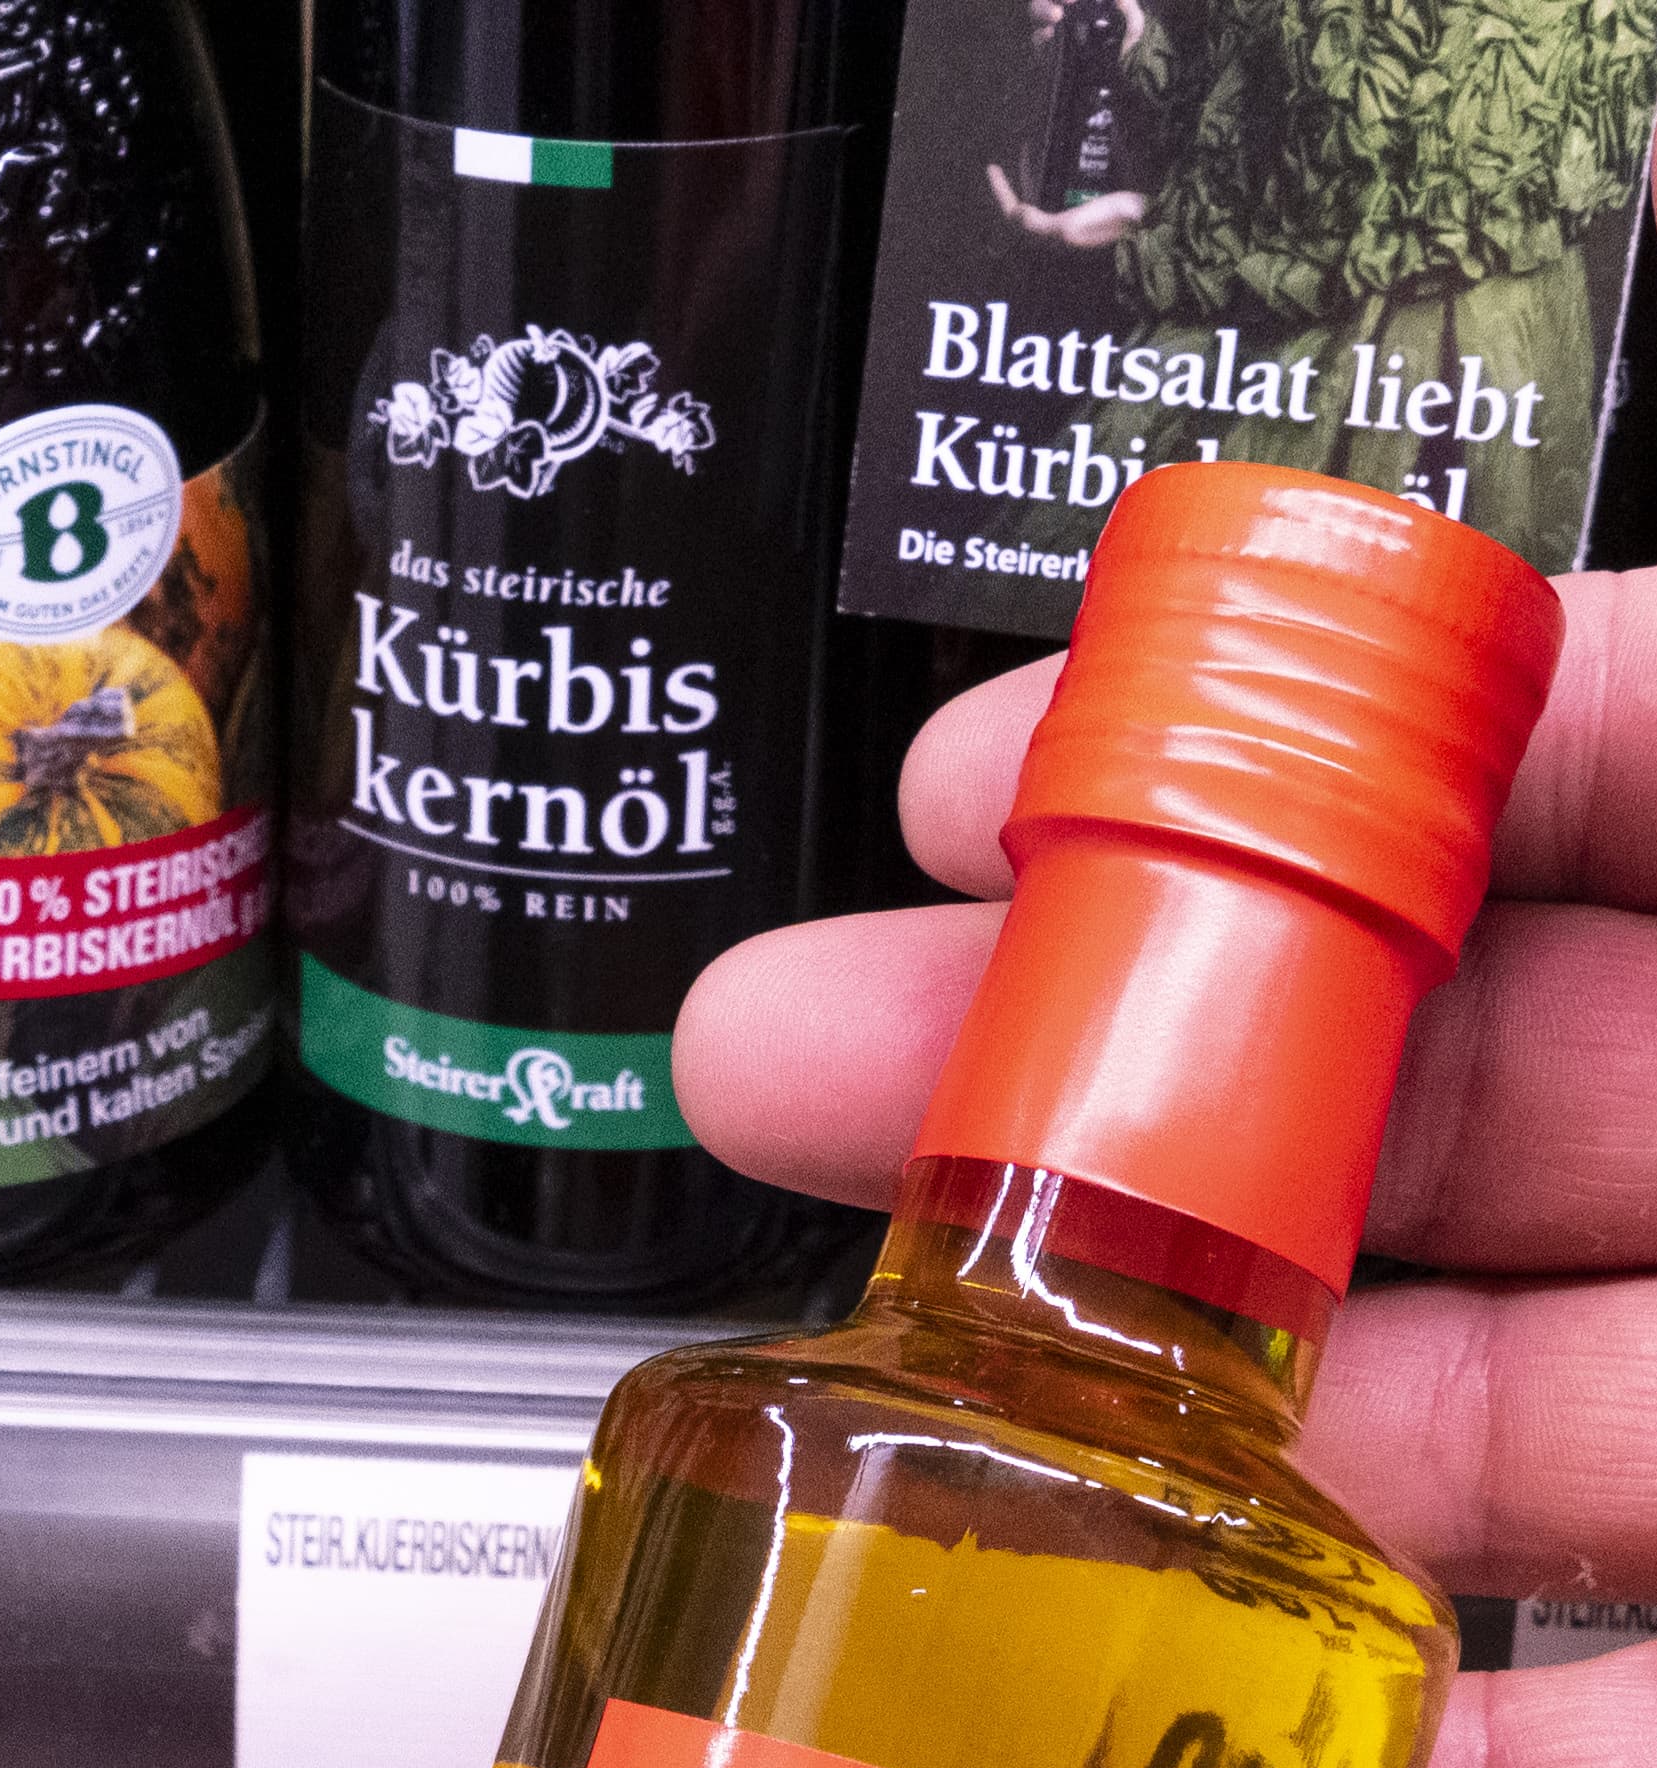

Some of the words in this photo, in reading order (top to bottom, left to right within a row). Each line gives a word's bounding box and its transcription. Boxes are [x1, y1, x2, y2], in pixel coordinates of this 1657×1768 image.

[923, 301, 1318, 422] Blattsalat
[1345, 345, 1545, 448] liebt
[390, 539, 449, 591] das
[462, 562, 670, 609] steirische
[898, 529, 955, 566] Die
[15, 598, 76, 621] GUTEN
[353, 592, 719, 735] Kürbis
[351, 709, 716, 858] kernöl
[30, 877, 72, 923] %
[405, 870, 502, 914] 100%
[525, 891, 632, 923] REIN
[144, 1008, 209, 1062] von
[89, 1061, 197, 1128] kalten
